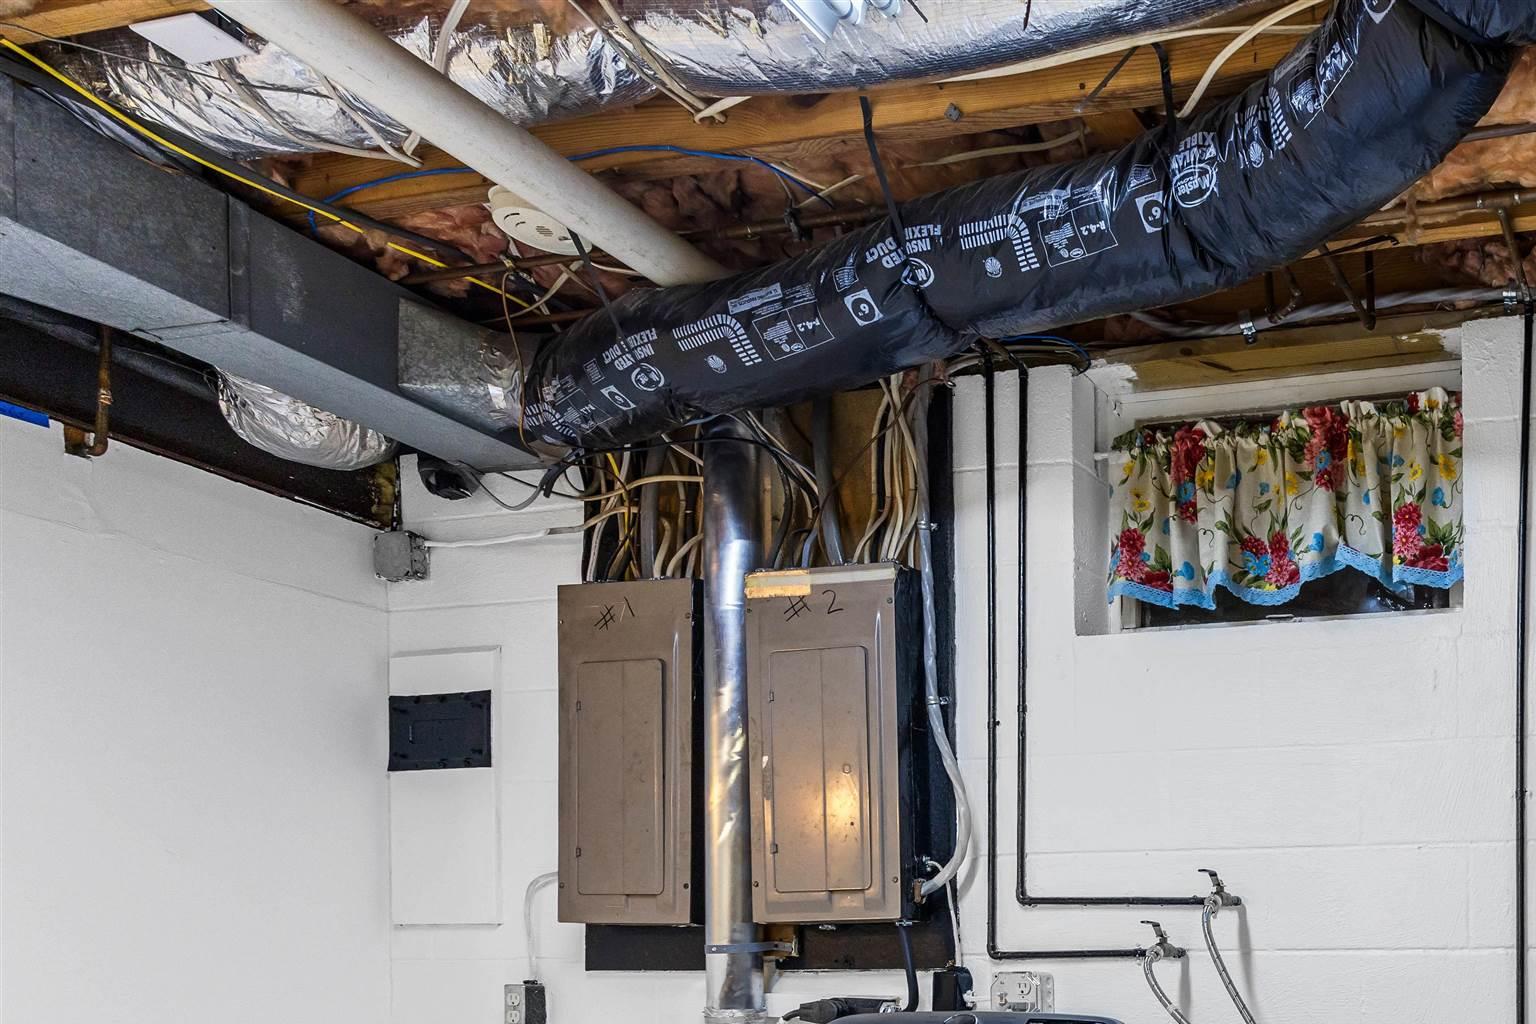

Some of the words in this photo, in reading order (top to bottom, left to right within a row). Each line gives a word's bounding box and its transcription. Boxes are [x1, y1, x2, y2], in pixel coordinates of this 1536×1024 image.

[865, 237, 897, 263] DUCT
[601, 342, 621, 364] DUCT
[614, 343, 655, 371] INSUATED
